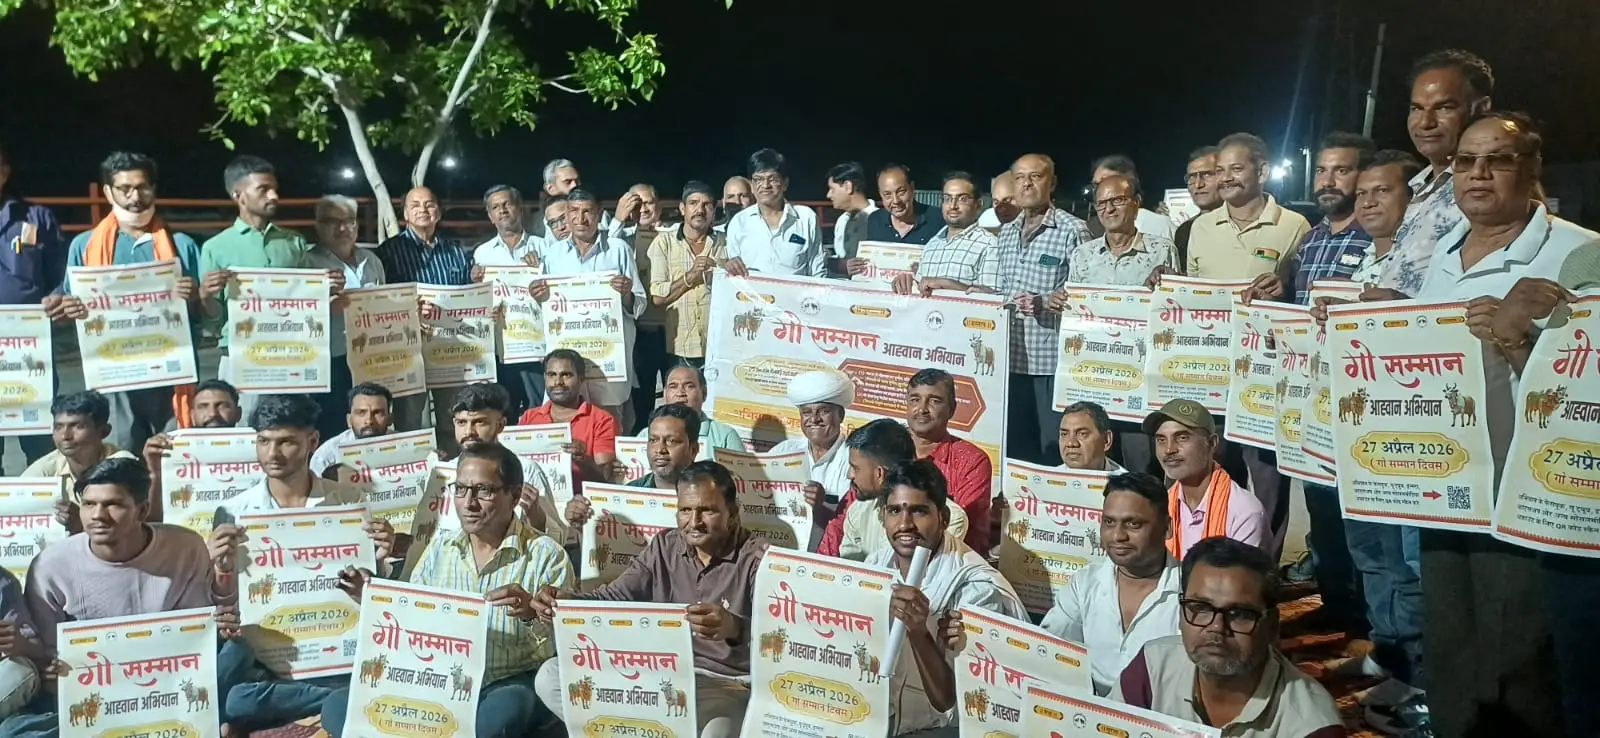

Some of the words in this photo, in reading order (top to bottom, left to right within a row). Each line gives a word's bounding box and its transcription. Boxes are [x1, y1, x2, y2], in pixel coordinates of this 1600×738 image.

[267, 298, 319, 317] सम्मान
[1187, 308, 1232, 330] सम्मा
[807, 326, 880, 355] सम्मान
[1109, 341, 1134, 356] अभियान
[1176, 335, 1200, 346] आह्वान
[1202, 334, 1229, 347] अभियान
[882, 342, 923, 360] आह्वान
[925, 346, 966, 367] अभियान
[1168, 361, 1179, 369] 27
[1078, 365, 1088, 373] 27
[1115, 369, 1137, 378] 2026
[1378, 352, 1466, 388] सम्मान
[1247, 390, 1256, 398] 27
[1370, 399, 1402, 416] आह्वान
[1404, 394, 1442, 416] अभियान
[1560, 400, 1600, 424] आह्वान
[1361, 442, 1376, 453] 27
[1381, 438, 1414, 455] अप्रैल
[1419, 444, 1454, 456] 2026
[1544, 450, 1563, 464] 27
[375, 460, 428, 483] सम्मान
[1389, 459, 1417, 470] सम्मान
[1418, 457, 1442, 471] दिवस
[748, 480, 802, 499] सम्मान
[1042, 500, 1103, 526] सम्मान
[769, 530, 789, 540] 2026
[1031, 527, 1055, 543] आह्वान
[1056, 530, 1084, 547] अभियान
[4, 542, 34, 557] अभियान
[288, 544, 360, 570] सम्मान
[277, 580, 307, 594] आह्वान
[270, 616, 283, 625] 27
[287, 610, 316, 623] अप्रैल
[321, 609, 349, 620] 2026
[801, 603, 874, 638] सम्मान
[405, 629, 473, 662] सम्मान
[788, 641, 817, 662] आह्वान
[818, 644, 852, 669] अभियान
[118, 652, 201, 686] सम्मान
[603, 649, 679, 680] सम्मान
[386, 665, 415, 685] आह्वान
[415, 667, 448, 690] अभियान
[104, 697, 138, 715] आह्वान
[141, 691, 179, 710] अभियान
[595, 687, 624, 704] आह्वान
[626, 685, 659, 707] अभियान
[780, 679, 793, 689] 27
[798, 680, 826, 698] अप्रैल
[830, 690, 859, 706] 2026
[375, 703, 387, 713] 27
[390, 703, 418, 719] अप्रैल
[421, 711, 448, 723] 2026
[593, 723, 605, 732] 27
[609, 722, 637, 736] अप्रैल
[641, 727, 669, 738] 2026
